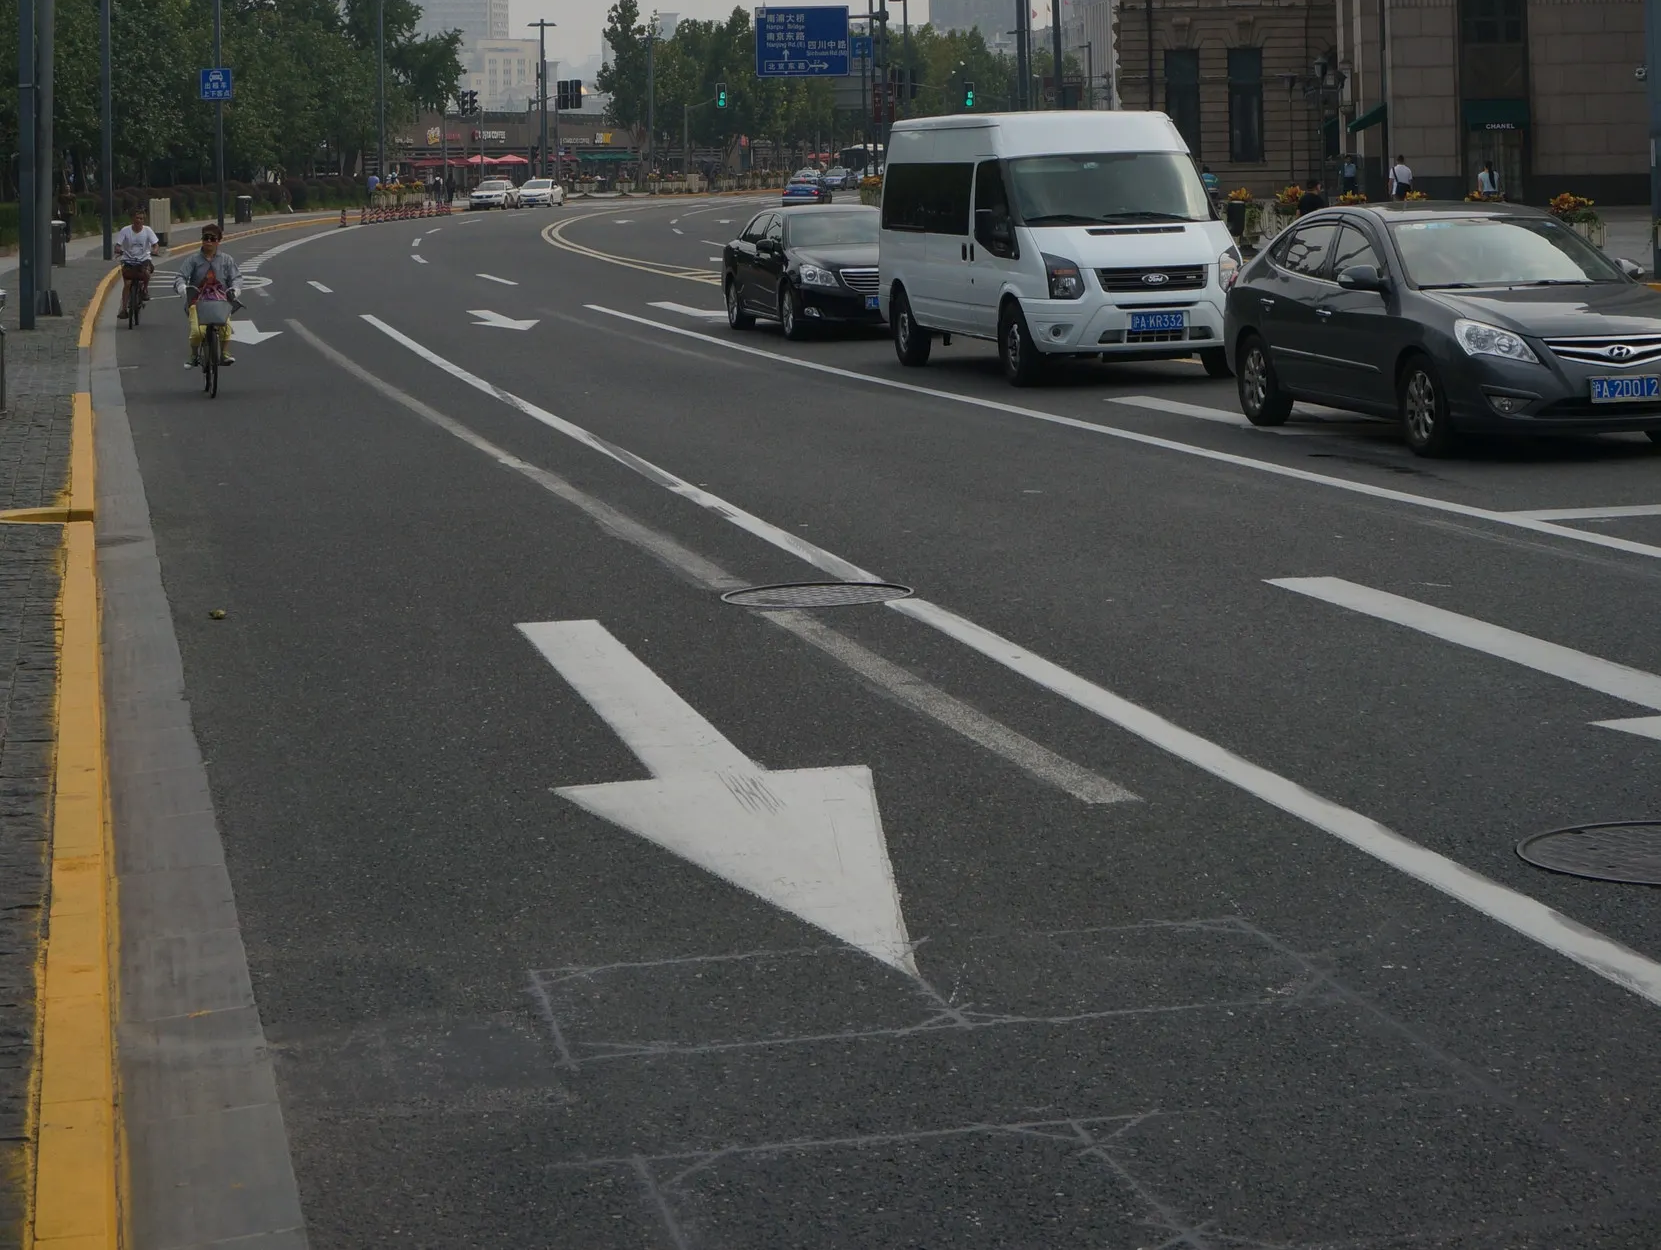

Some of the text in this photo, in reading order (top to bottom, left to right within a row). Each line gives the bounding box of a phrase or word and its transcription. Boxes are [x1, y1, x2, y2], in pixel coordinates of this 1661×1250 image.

[766, 13, 805, 23] 南浦大桥
[787, 23, 805, 31] Bridge
[766, 31, 805, 41] 南京东路
[766, 41, 787, 49] Nanjing
[807, 40, 847, 49] 四川中路
[768, 61, 806, 70] 北京东路
[204, 82, 227, 90] 出租车
[1147, 274, 1164, 283] Ford
